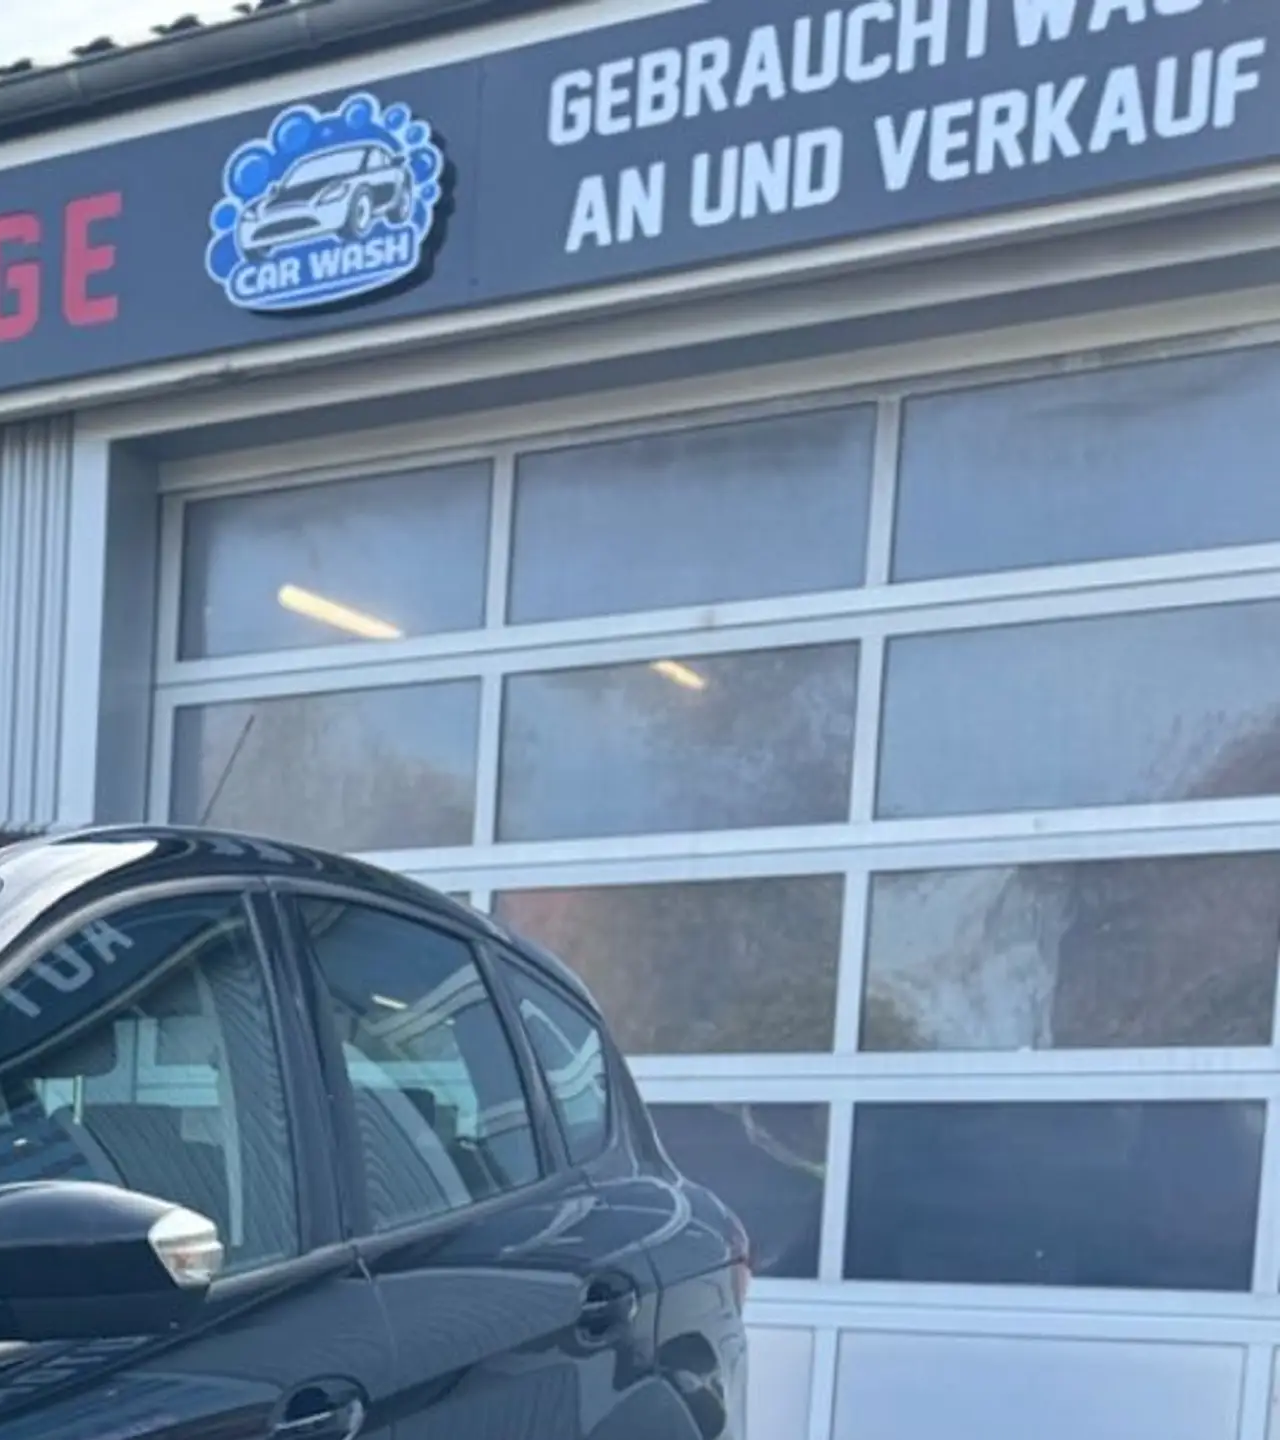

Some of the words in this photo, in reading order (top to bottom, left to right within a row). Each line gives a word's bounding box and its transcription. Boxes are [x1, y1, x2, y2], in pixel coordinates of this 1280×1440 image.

[564, 162, 665, 253] AN
[690, 128, 842, 227] UND
[874, 37, 1267, 191] VERKAUF
[235, 256, 301, 296] CAR
[308, 231, 410, 281] WASH
